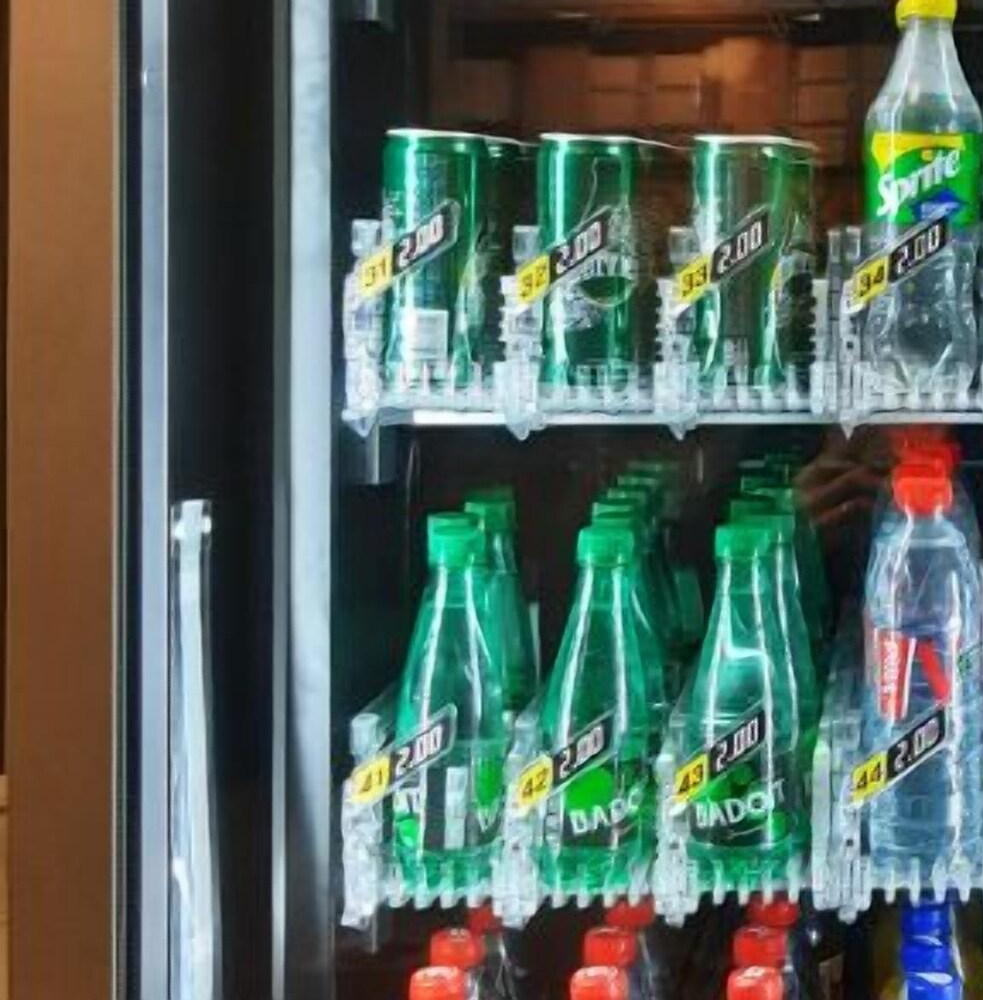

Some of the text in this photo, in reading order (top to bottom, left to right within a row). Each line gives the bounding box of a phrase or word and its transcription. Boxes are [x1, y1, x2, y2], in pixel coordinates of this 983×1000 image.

[877, 149, 961, 222] Sprite
[398, 214, 444, 268] 2.00
[555, 221, 602, 274] 2.00
[717, 221, 762, 274] 2.00
[897, 226, 939, 273] 2.00
[396, 725, 441, 776] 2.00
[559, 725, 604, 778] 2.00
[716, 718, 758, 771] 2.00
